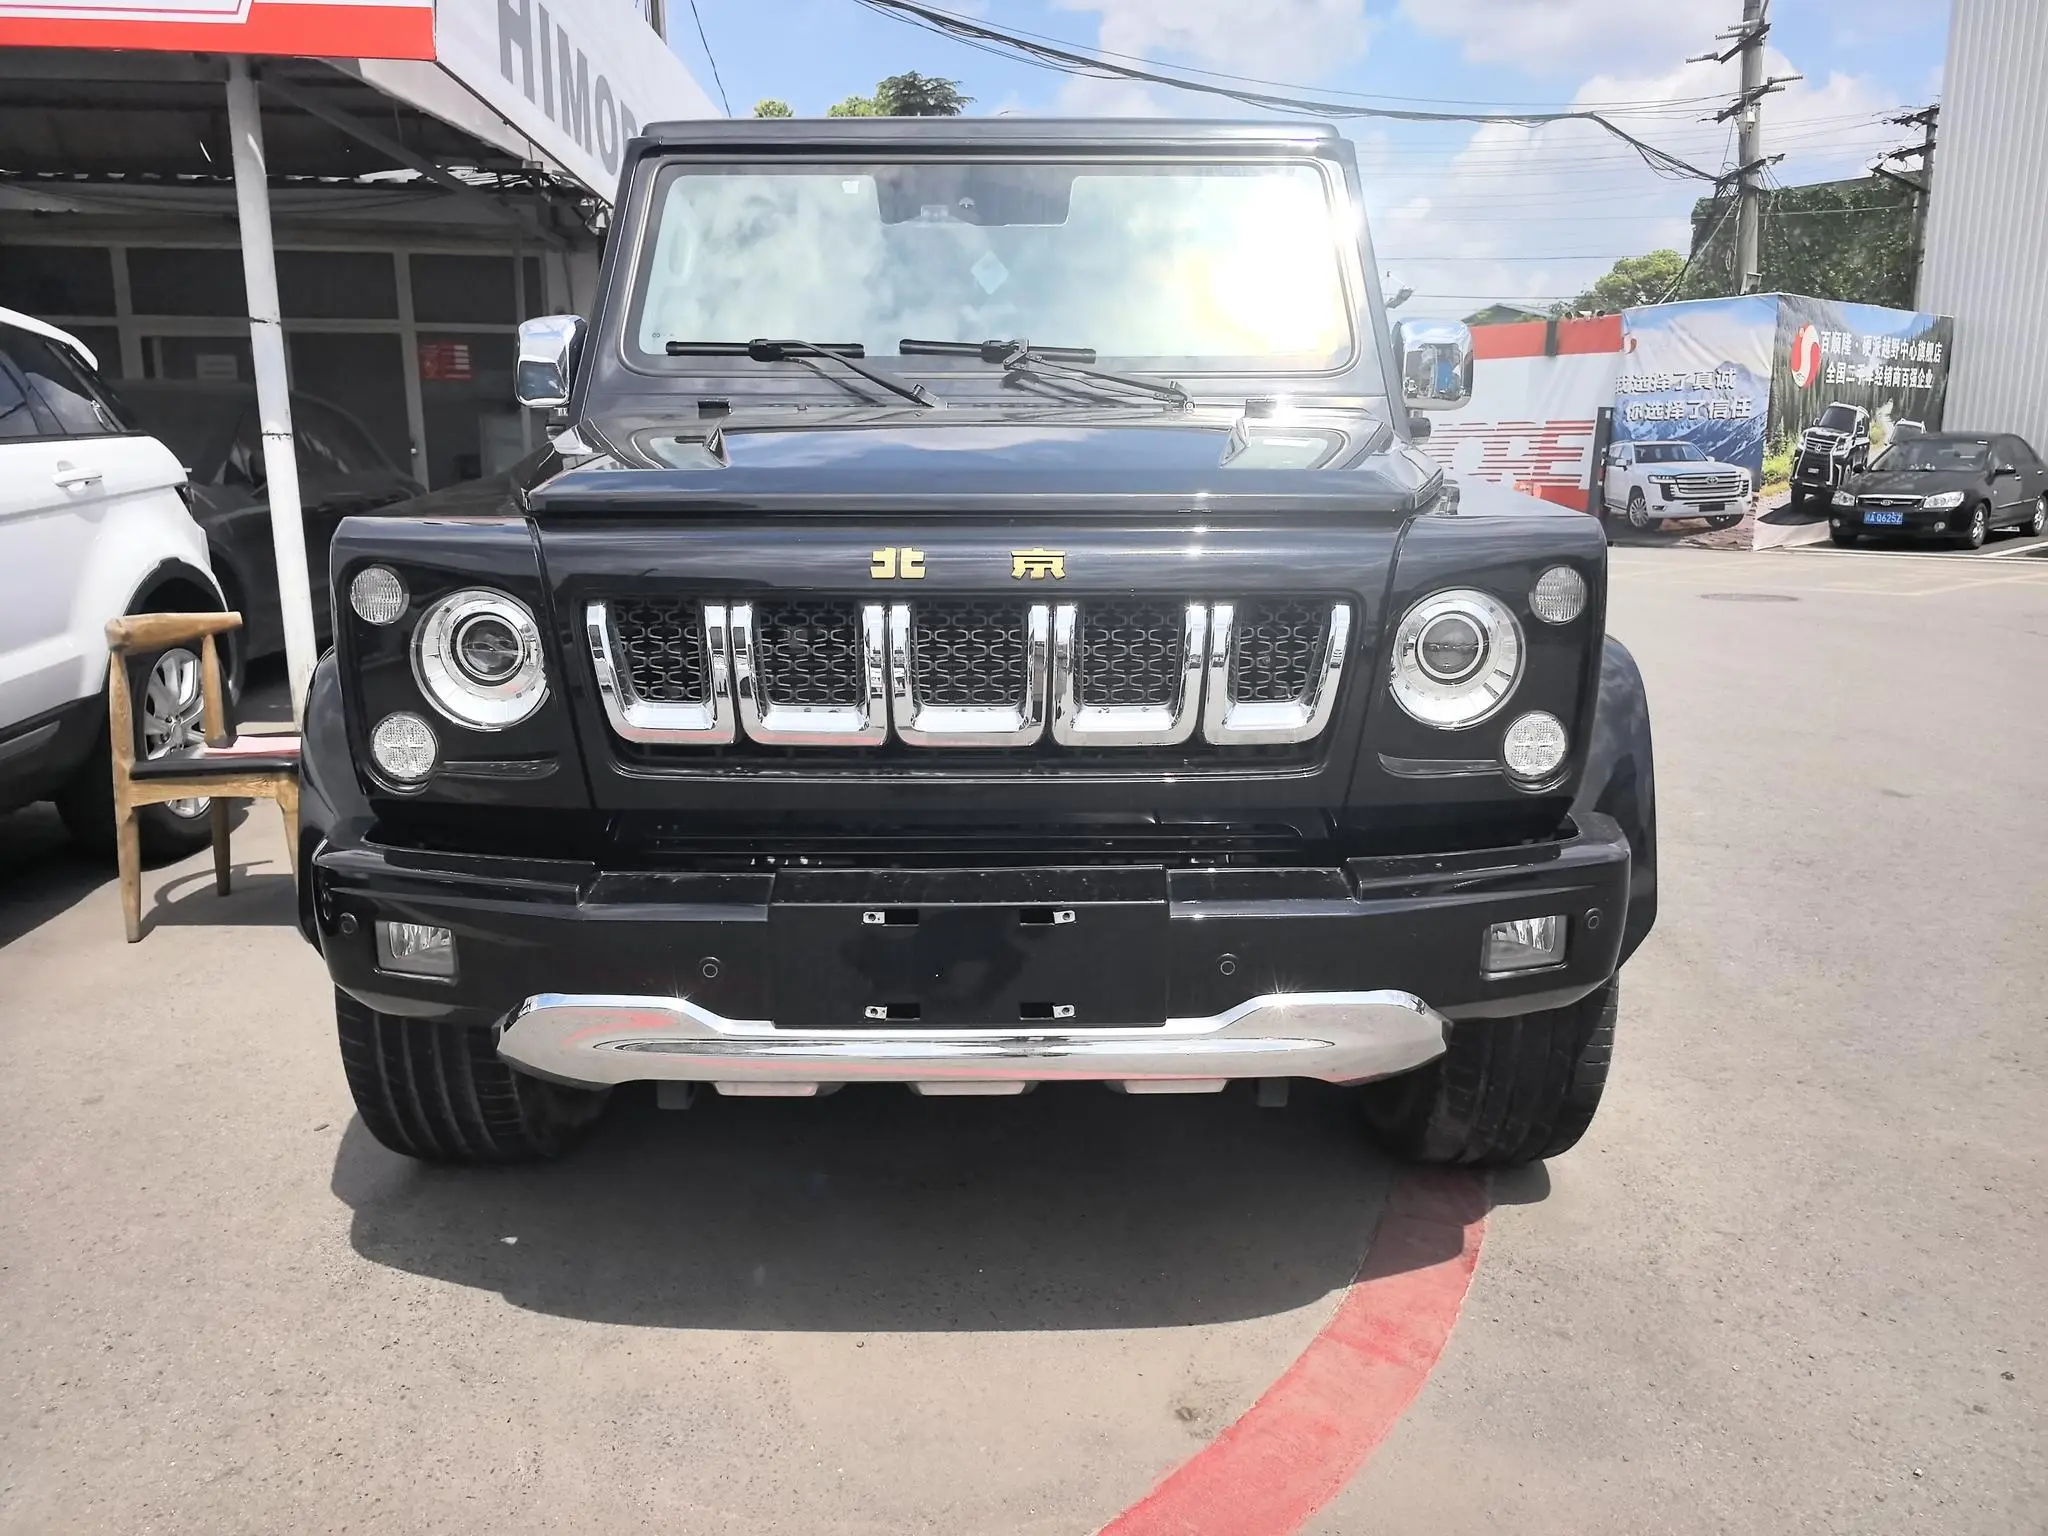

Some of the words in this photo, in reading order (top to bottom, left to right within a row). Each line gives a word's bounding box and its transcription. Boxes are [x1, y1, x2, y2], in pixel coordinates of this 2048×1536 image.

[1625, 398, 1753, 422] 你选择了信任
